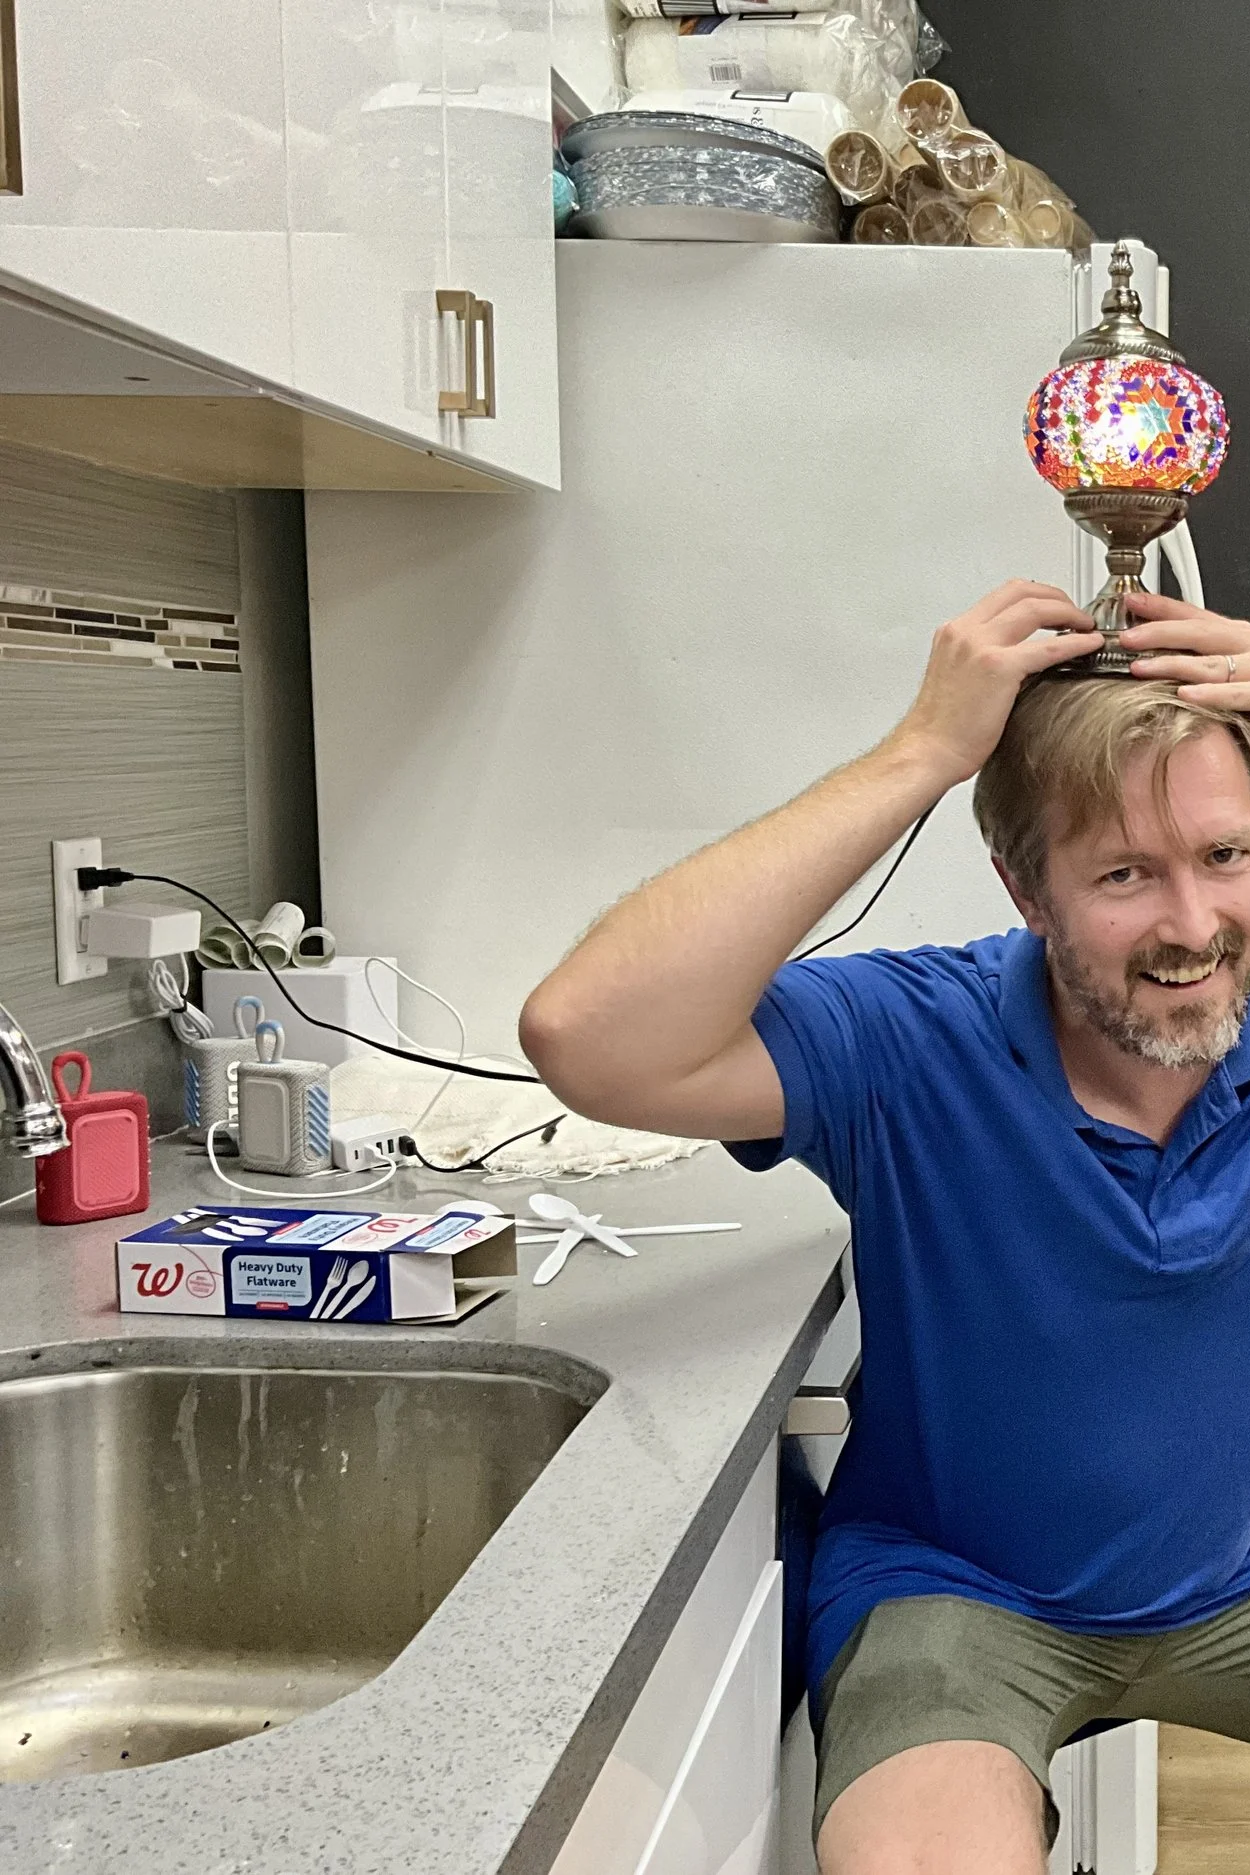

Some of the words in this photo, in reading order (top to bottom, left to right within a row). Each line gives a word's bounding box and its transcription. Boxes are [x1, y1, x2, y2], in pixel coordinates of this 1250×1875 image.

[238, 1262, 273, 1274] Heavy
[276, 1262, 303, 1276] Duty
[247, 1276, 297, 1288] Flatware
